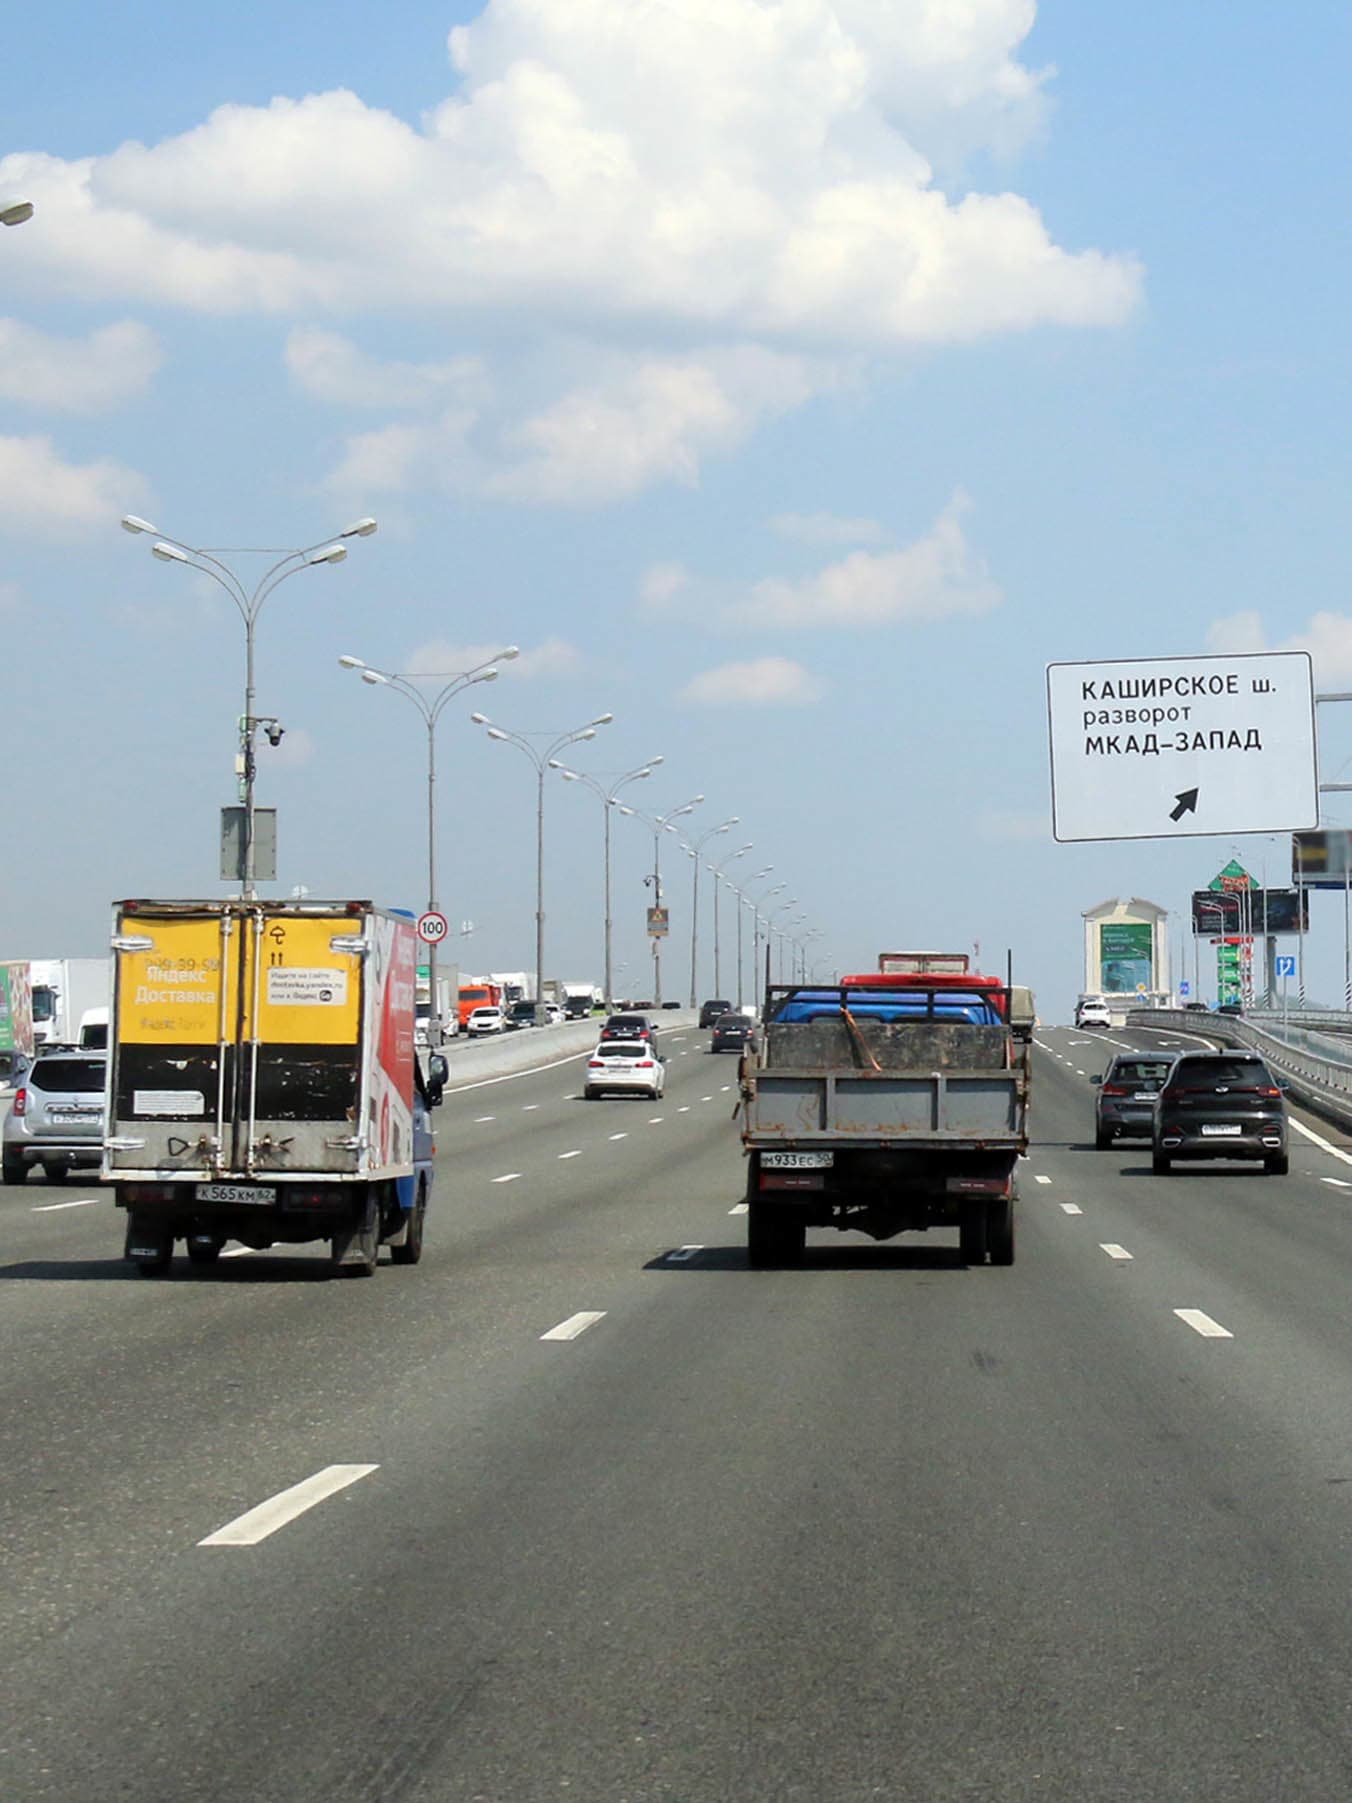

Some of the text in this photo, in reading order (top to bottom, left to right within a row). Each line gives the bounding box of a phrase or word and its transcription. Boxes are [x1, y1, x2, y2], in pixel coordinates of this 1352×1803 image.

[1082, 675, 1277, 701] КАШИРСКОЕ ш.
[1083, 706, 1191, 731] разворот
[1085, 729, 1262, 756] МКАД-ЗАПАД
[422, 922, 443, 935] 100
[147, 965, 208, 985] Яндекс
[134, 986, 217, 1006] Доставка
